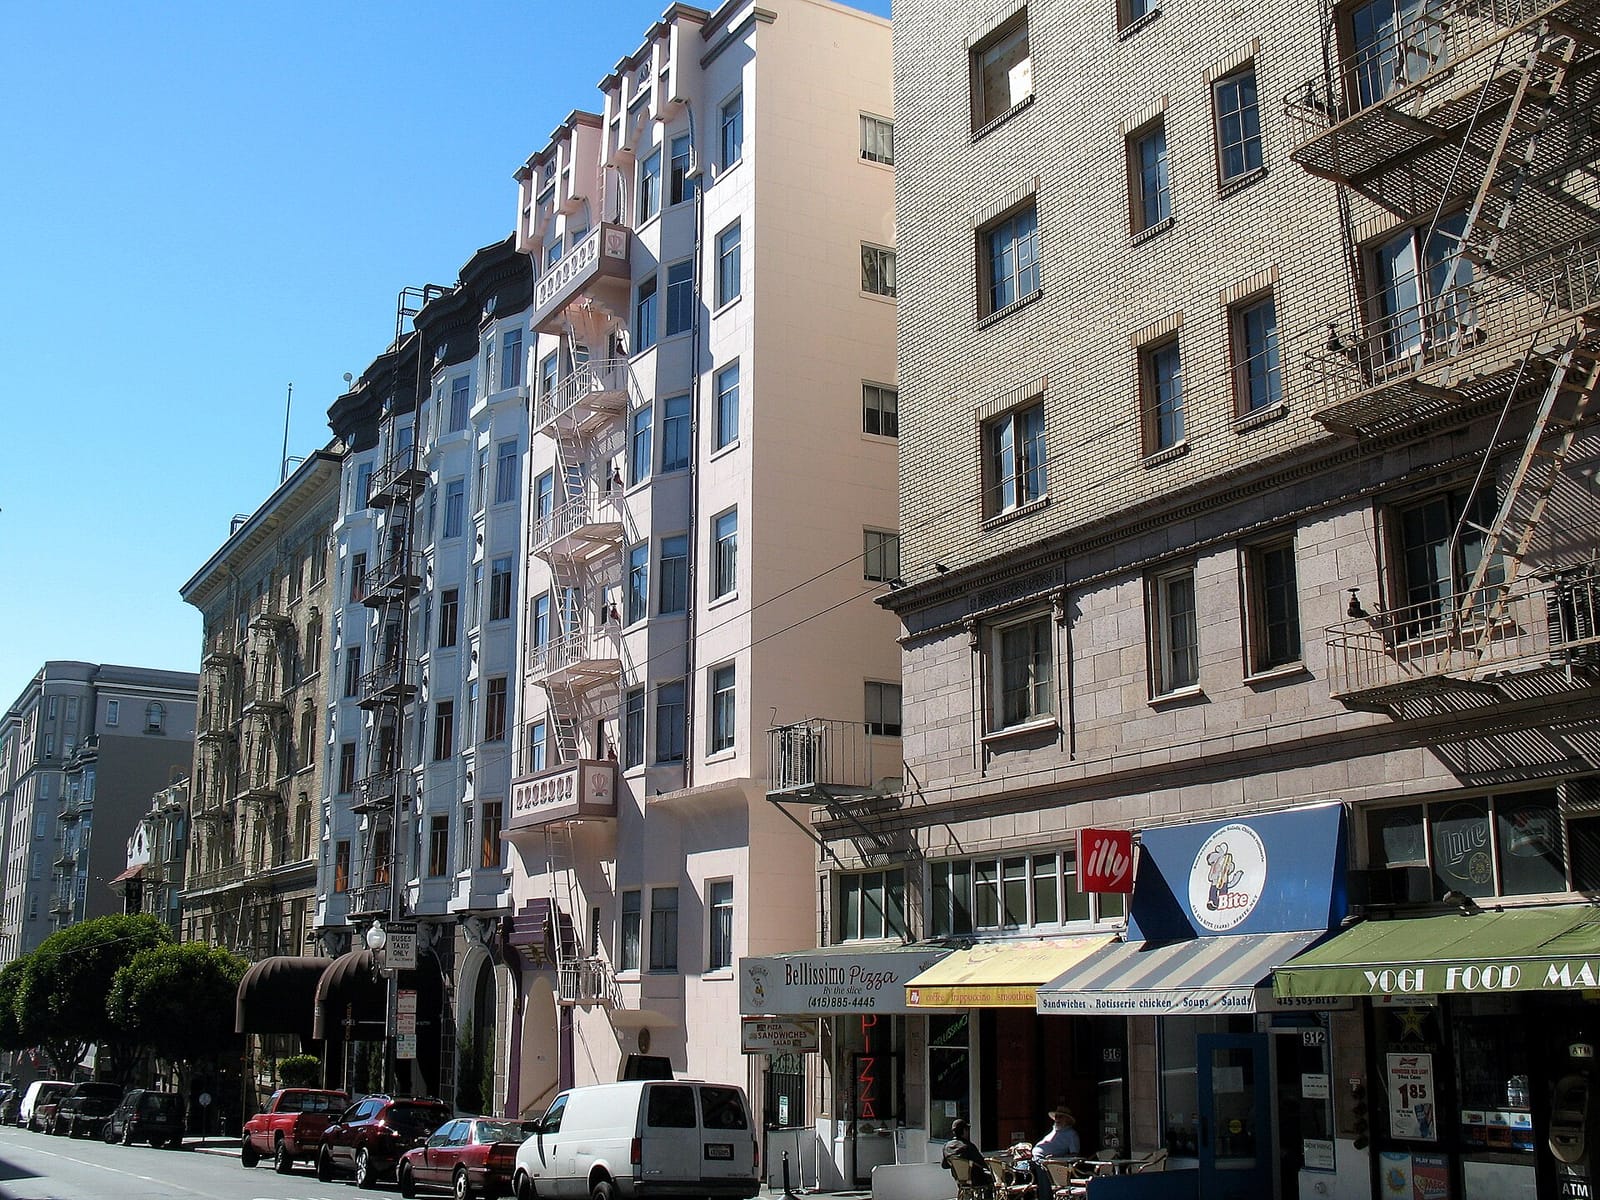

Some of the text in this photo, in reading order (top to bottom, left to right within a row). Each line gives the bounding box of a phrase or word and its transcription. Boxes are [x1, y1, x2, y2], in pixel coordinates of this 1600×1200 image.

[1087, 838, 1129, 887] illy
[1217, 892, 1249, 911] Bite
[785, 962, 845, 986] Bellissimo
[849, 965, 899, 990] Pizza
[1364, 961, 1600, 993] YOGI FOOD MA
[834, 986, 845, 995] the
[846, 986, 862, 995] slice
[998, 991, 1034, 1001] smoothies
[1043, 999, 1086, 1009] Sandwiches
[1095, 998, 1138, 1009] Rotisserie
[1139, 997, 1172, 1008] chicken
[1183, 997, 1209, 1010] Soups
[758, 1031, 807, 1039] SANDWICHES
[1304, 1031, 1325, 1043] 912
[1103, 1048, 1121, 1060] 916
[1572, 1046, 1591, 1055] ATM
[858, 1014, 878, 1118] PIZZA
[1562, 1183, 1589, 1197] ATM
